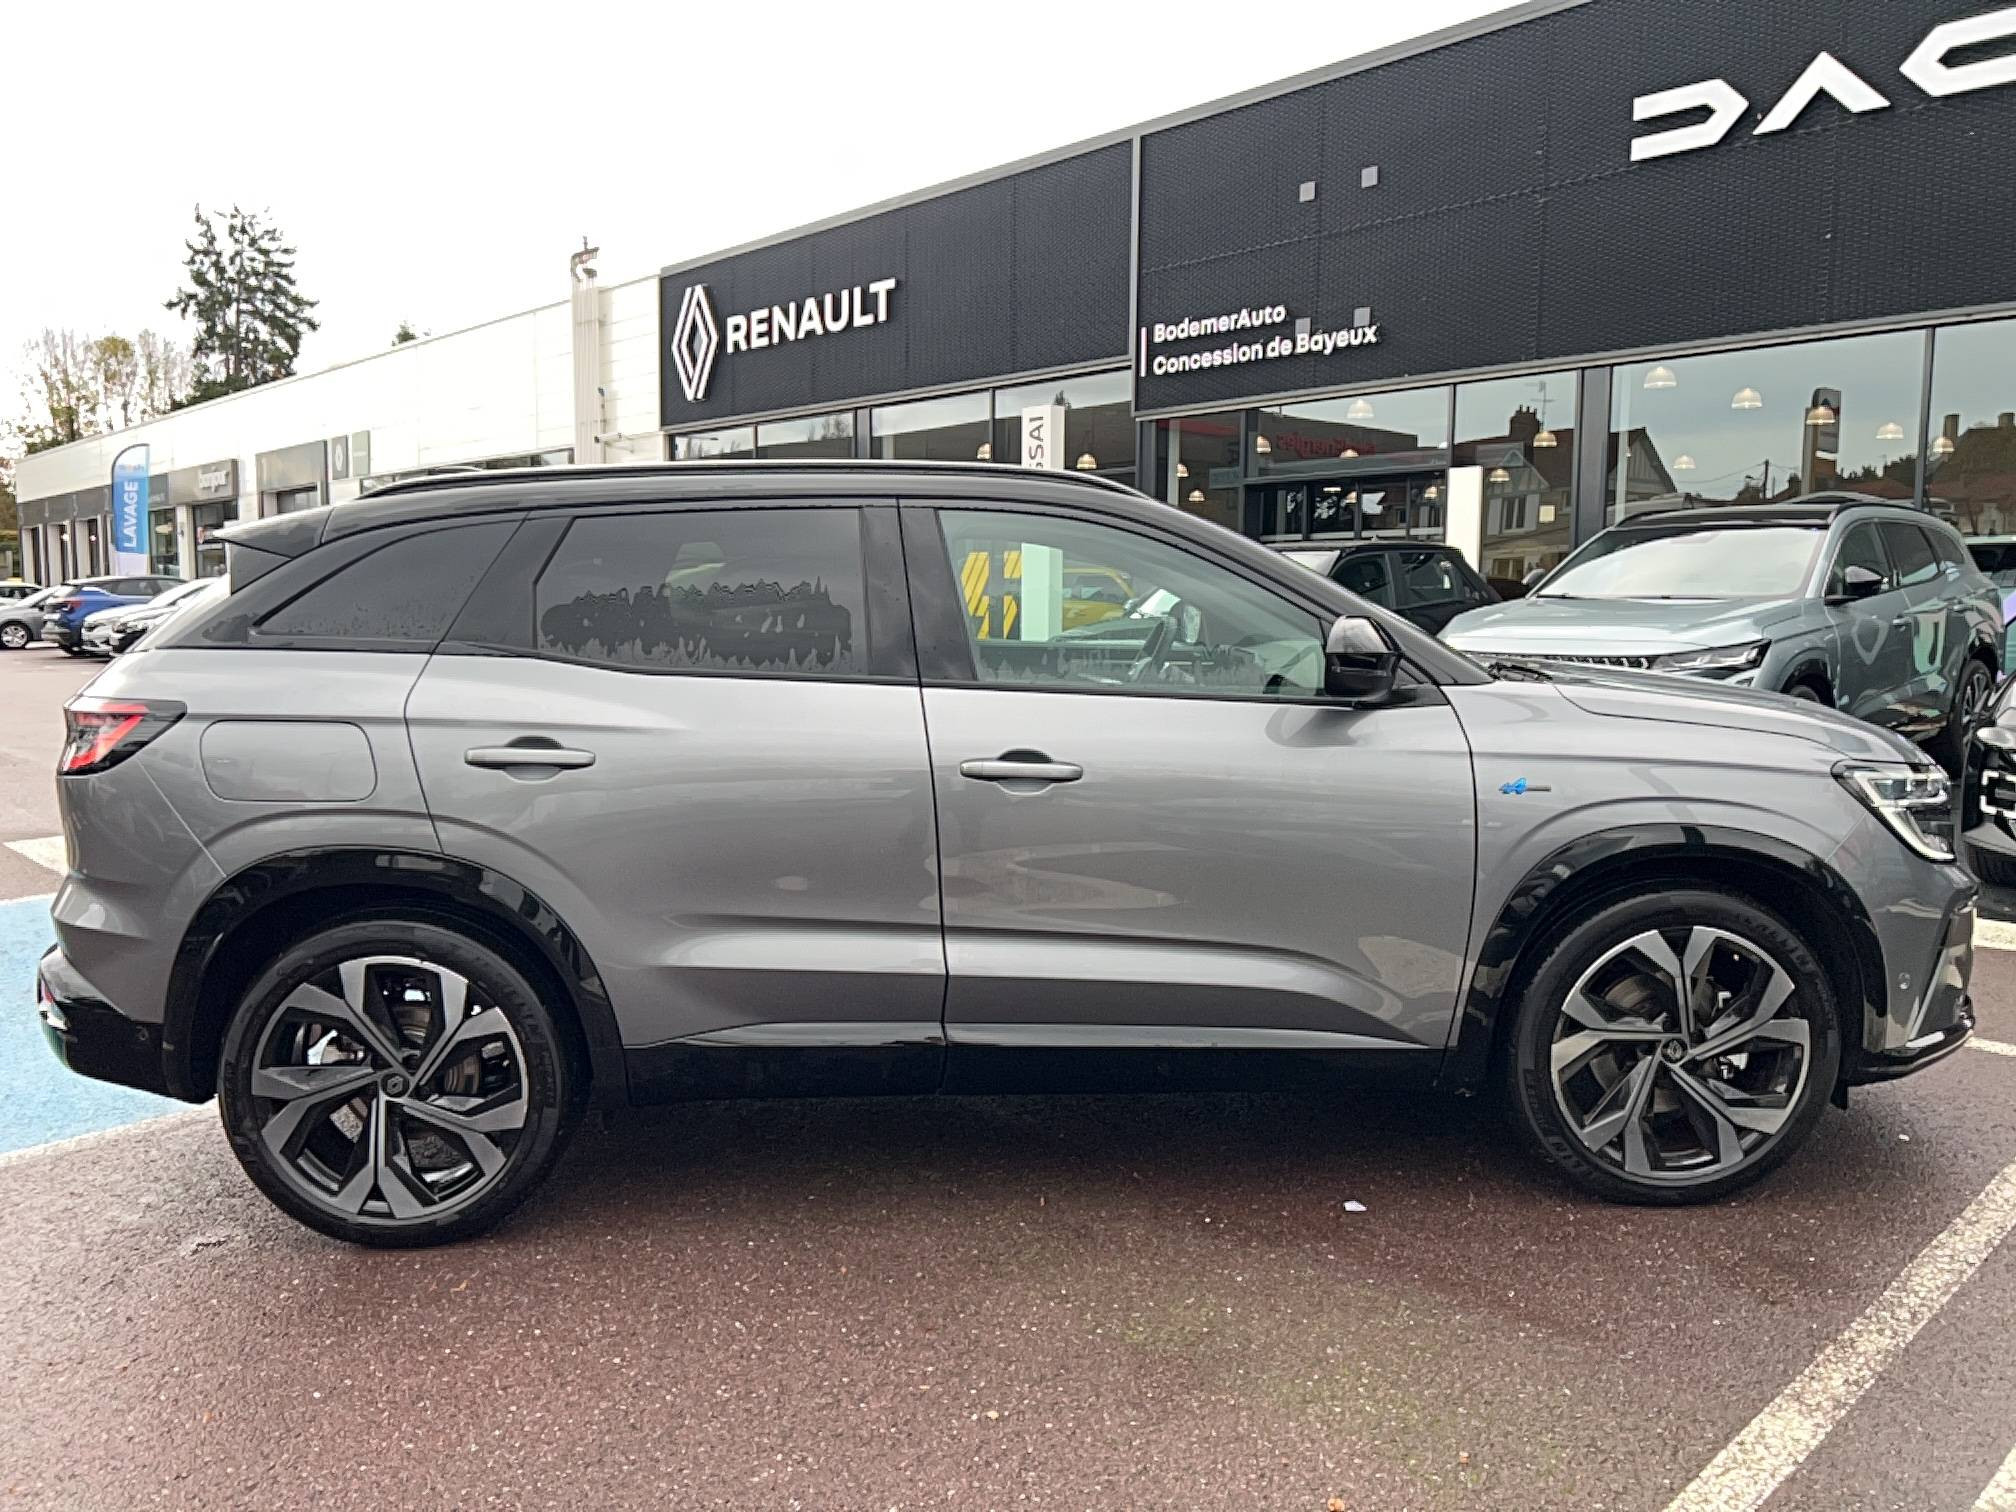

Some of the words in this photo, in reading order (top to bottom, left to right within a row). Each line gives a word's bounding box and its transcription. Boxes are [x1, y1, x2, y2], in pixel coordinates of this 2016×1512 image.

[726, 277, 896, 354] RENAULT
[1153, 305, 1287, 343] BodemerAuto
[1153, 343, 1264, 375] Concession
[1266, 336, 1293, 358] de
[1295, 325, 1378, 355] Bayeux
[123, 480, 138, 548] LAVAGE
